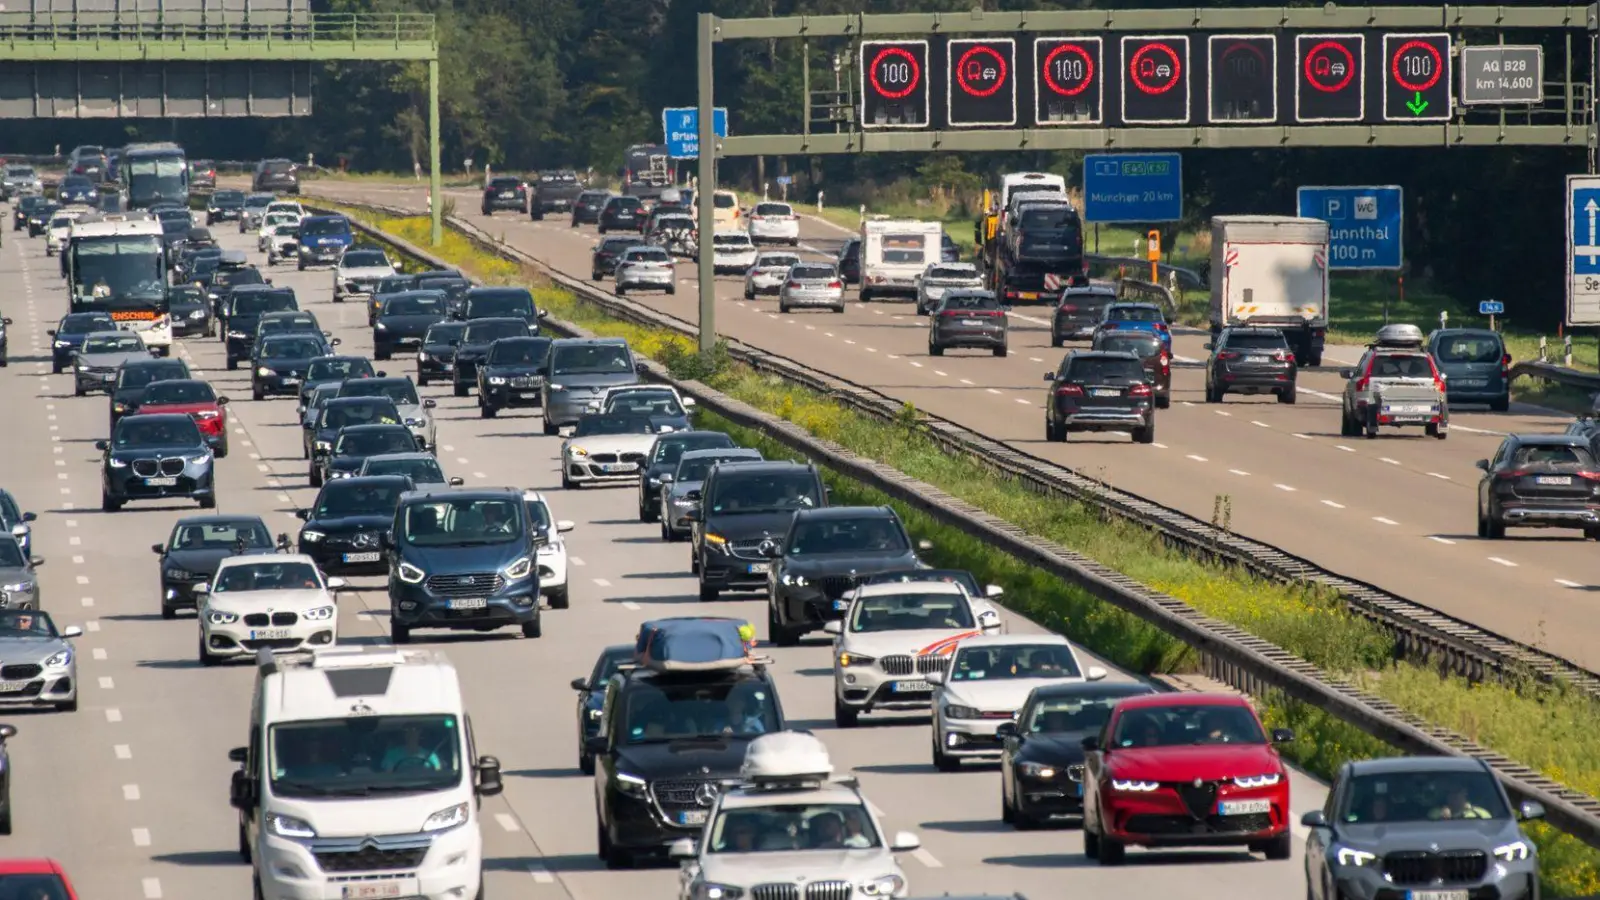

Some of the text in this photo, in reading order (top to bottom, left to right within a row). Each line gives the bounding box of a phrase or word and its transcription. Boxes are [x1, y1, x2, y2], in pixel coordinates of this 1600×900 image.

[882, 63, 909, 83] 100
[1055, 59, 1082, 80] 100
[1403, 56, 1431, 76] 100
[1482, 60, 1526, 73] AQ B28
[1476, 78, 1495, 89] km
[1091, 191, 1174, 202] München 20 km
[1328, 199, 1374, 217] P WC
[1362, 249, 1376, 259] m
